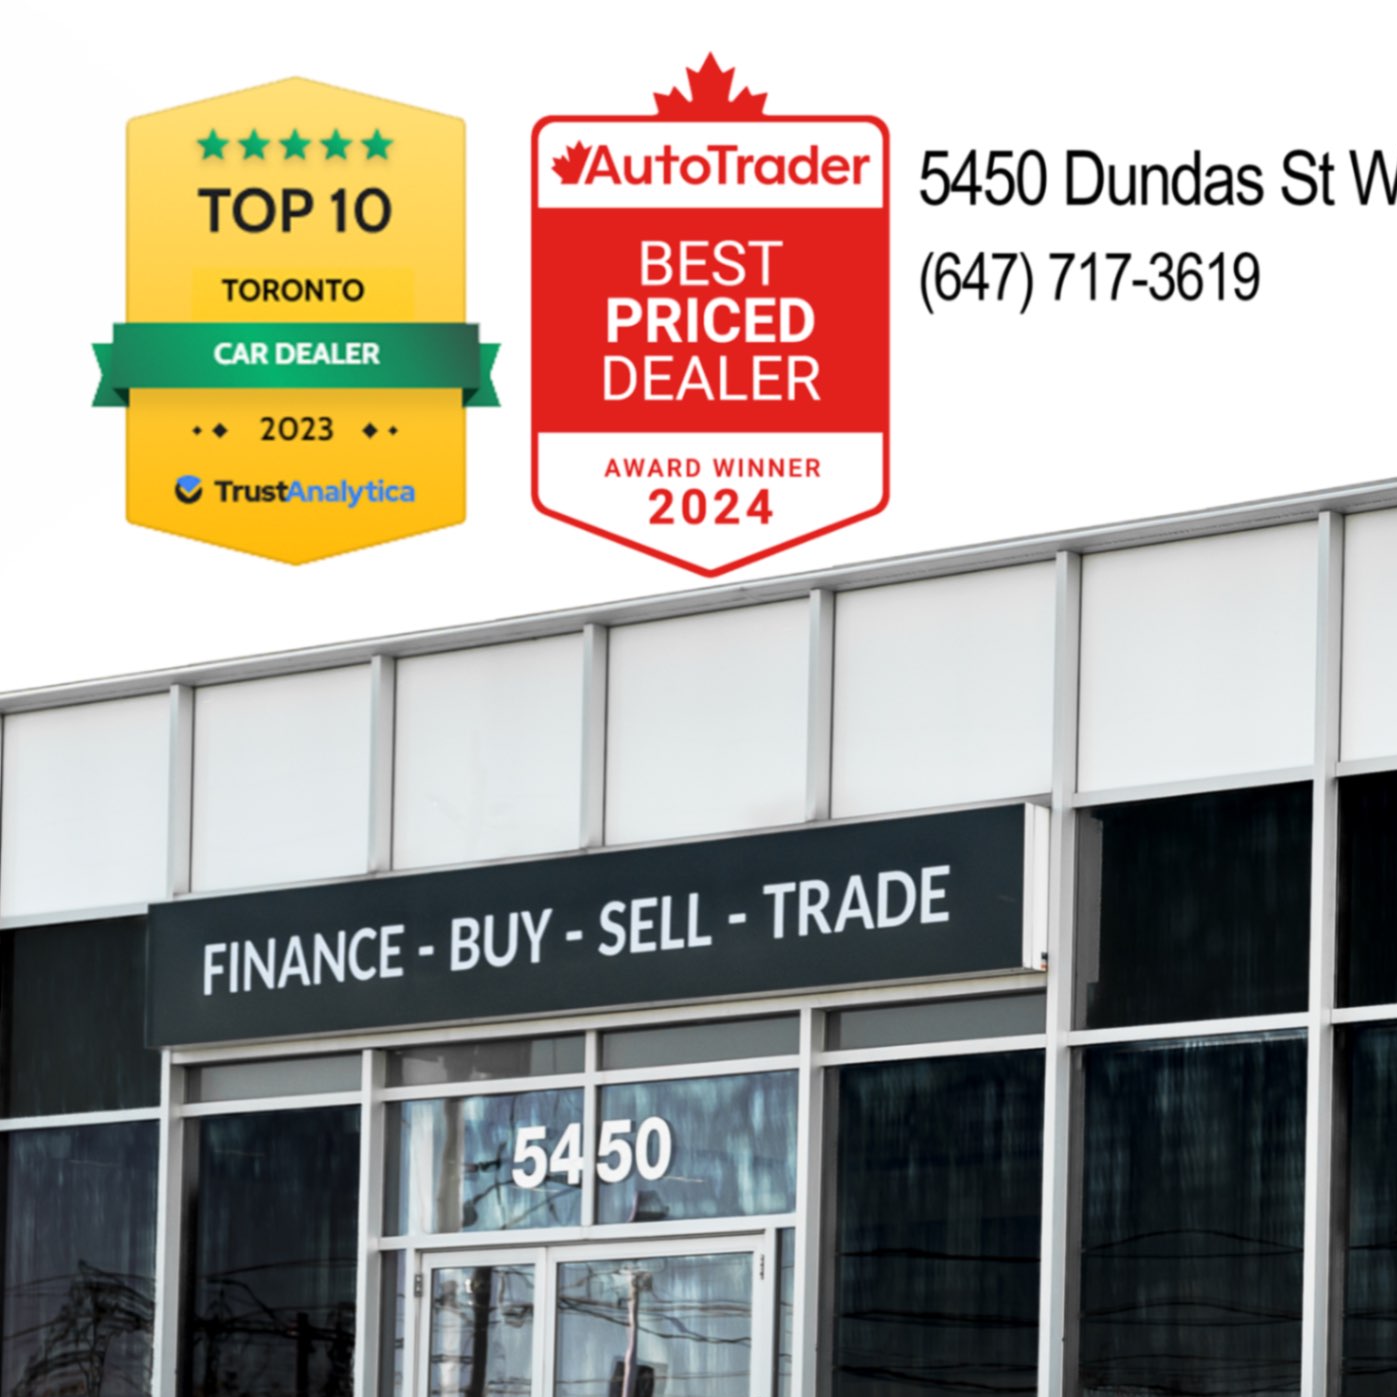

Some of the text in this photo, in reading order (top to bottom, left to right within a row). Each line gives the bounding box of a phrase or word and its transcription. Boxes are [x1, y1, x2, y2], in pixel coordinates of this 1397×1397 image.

[204, 925, 404, 995] FINANCE
[451, 909, 552, 971] BUY
[599, 893, 712, 956] SELL
[763, 865, 950, 938] TRADE
[511, 1117, 672, 1189] 5450
